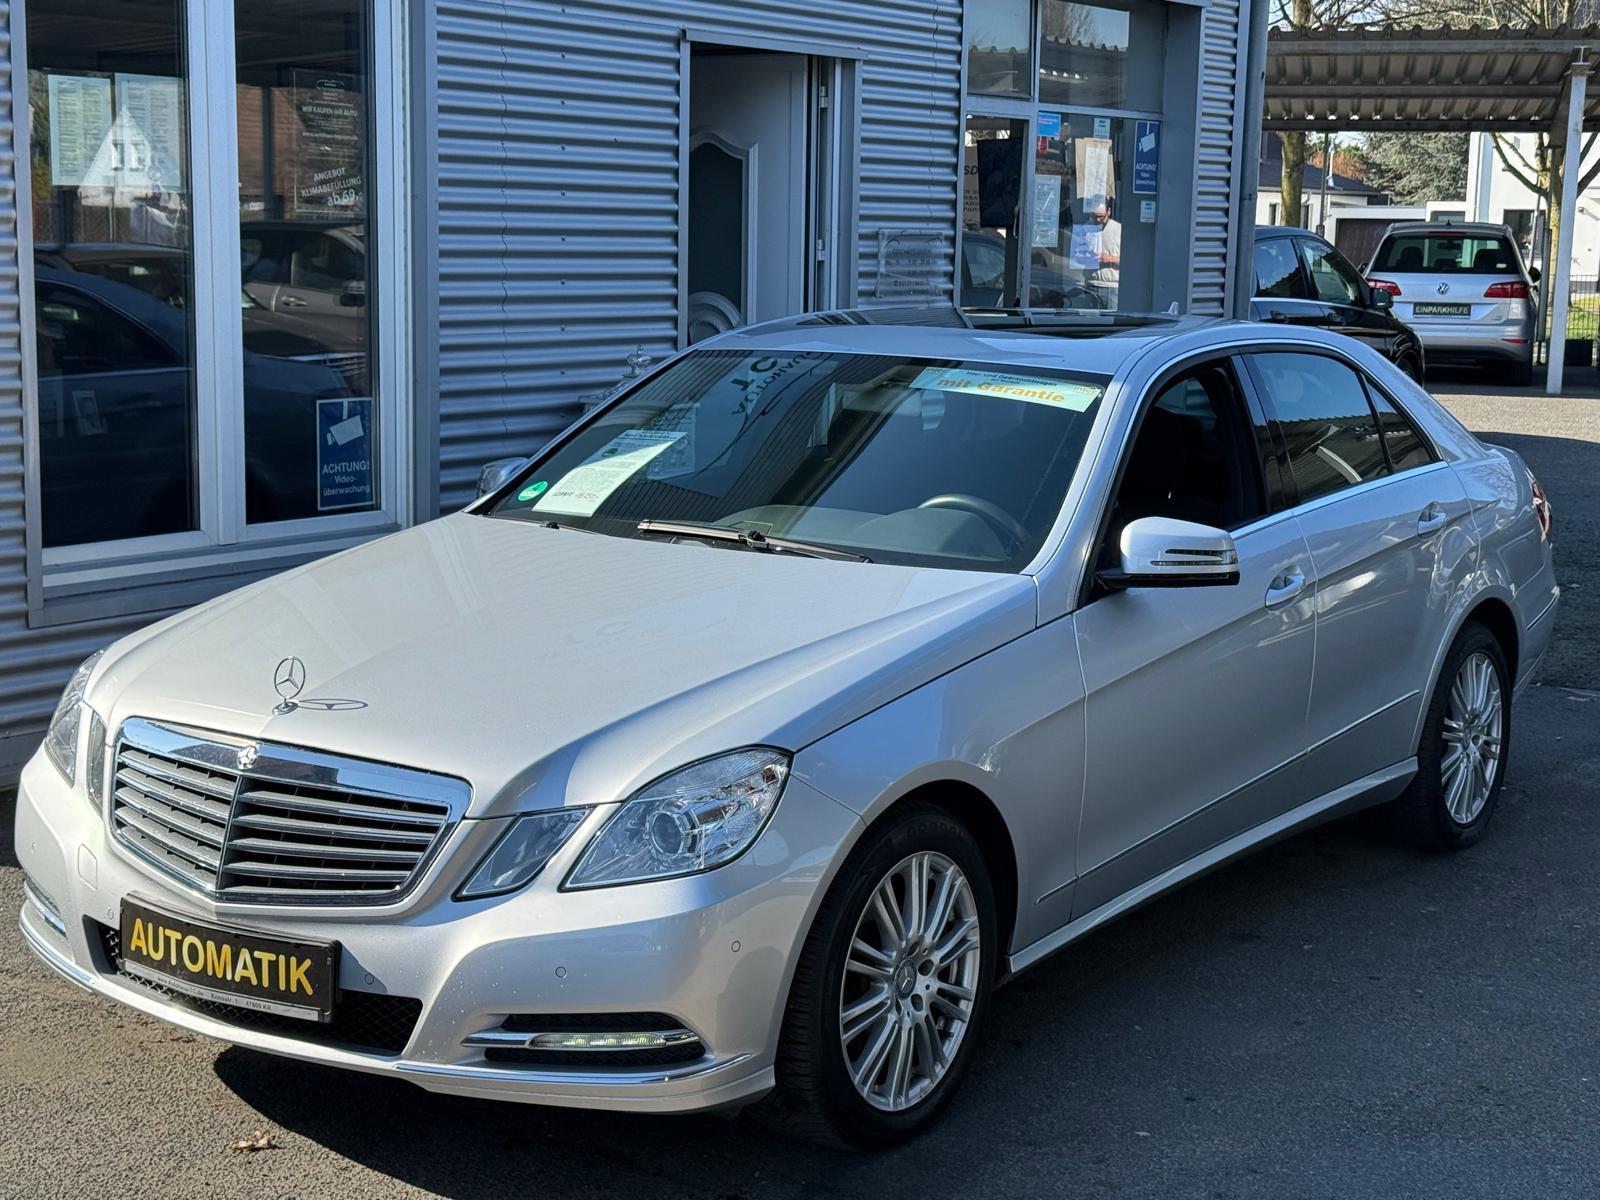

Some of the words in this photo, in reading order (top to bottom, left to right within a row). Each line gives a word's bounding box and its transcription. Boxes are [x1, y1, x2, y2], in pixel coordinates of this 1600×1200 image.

[313, 167, 346, 182] ANGEBOT
[301, 176, 362, 197] KLIMABEFÜLLUNG
[327, 192, 340, 206] ab
[1415, 305, 1469, 314] EINPARKHILFE
[937, 378, 972, 389] mit
[976, 382, 1065, 402] Garantie
[322, 460, 369, 475] ACHTUNG!
[335, 475, 357, 484] Video-
[323, 485, 370, 496] überwachung
[130, 918, 314, 996] AUTOMATIK
